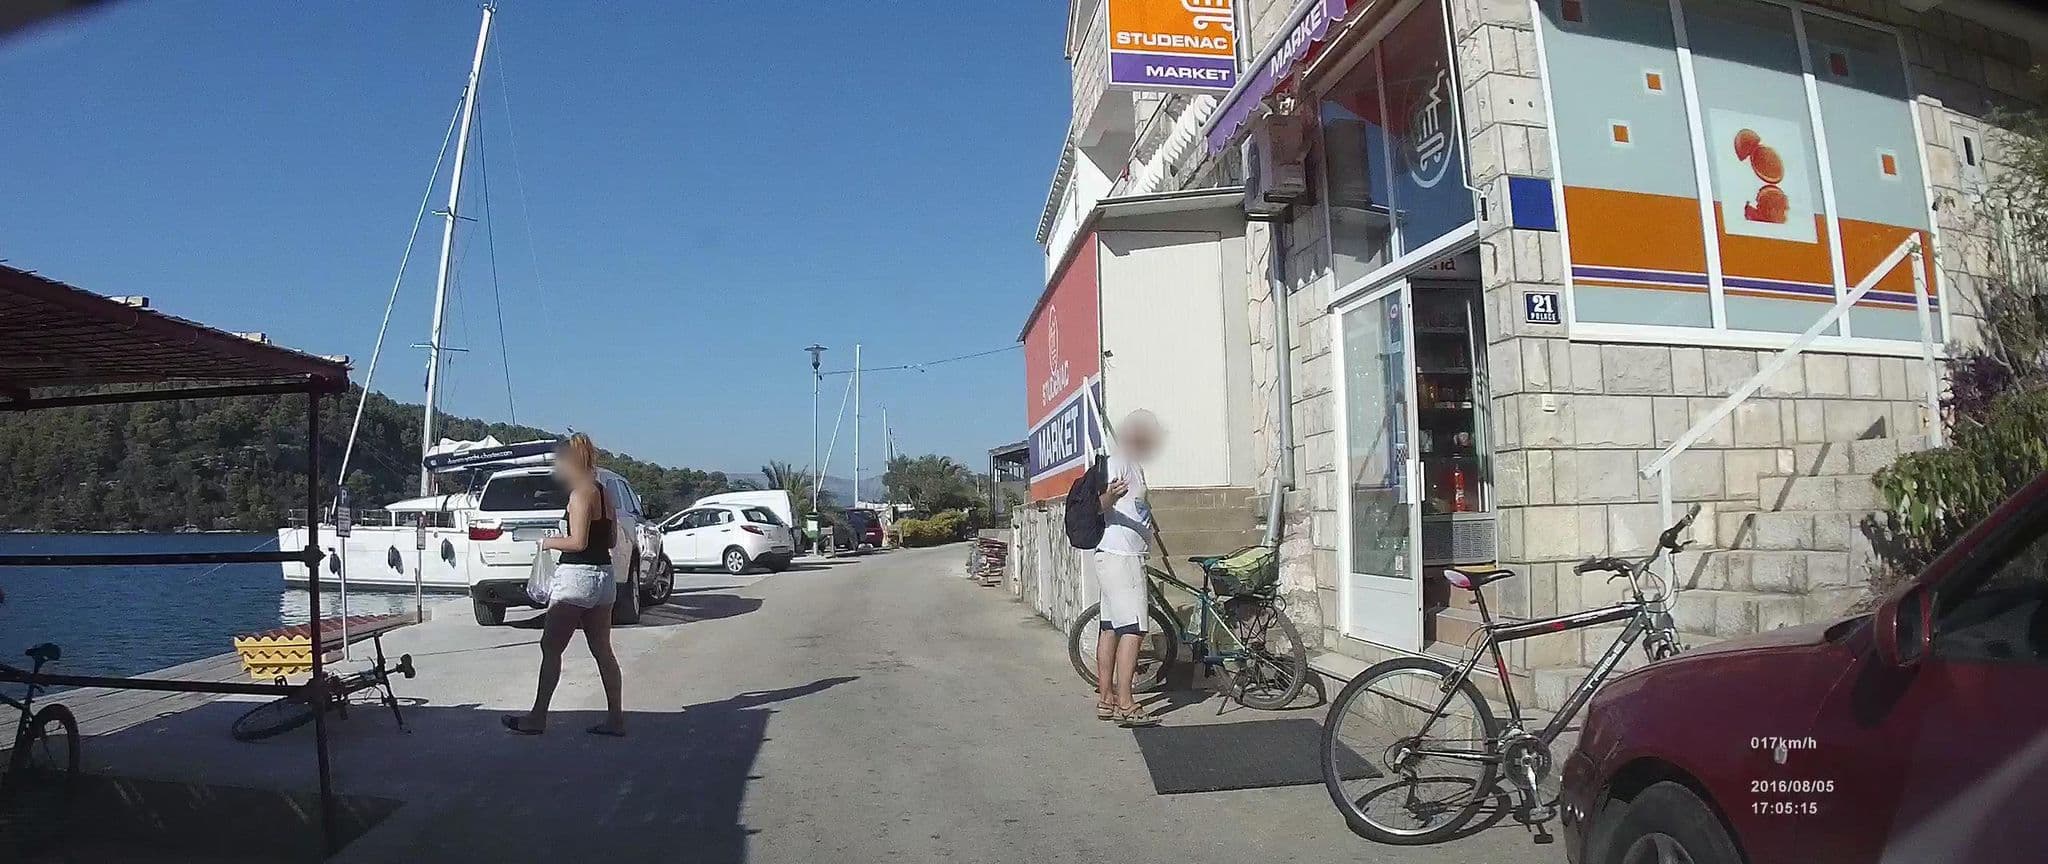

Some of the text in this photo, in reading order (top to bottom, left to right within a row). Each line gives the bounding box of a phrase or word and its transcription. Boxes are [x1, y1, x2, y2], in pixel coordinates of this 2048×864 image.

[1116, 31, 1228, 50] STUDENAC
[1270, 0, 1328, 77] MARKET
[1146, 65, 1230, 80] MARKET
[1532, 294, 1554, 313] 21
[1038, 404, 1079, 470] MARKET
